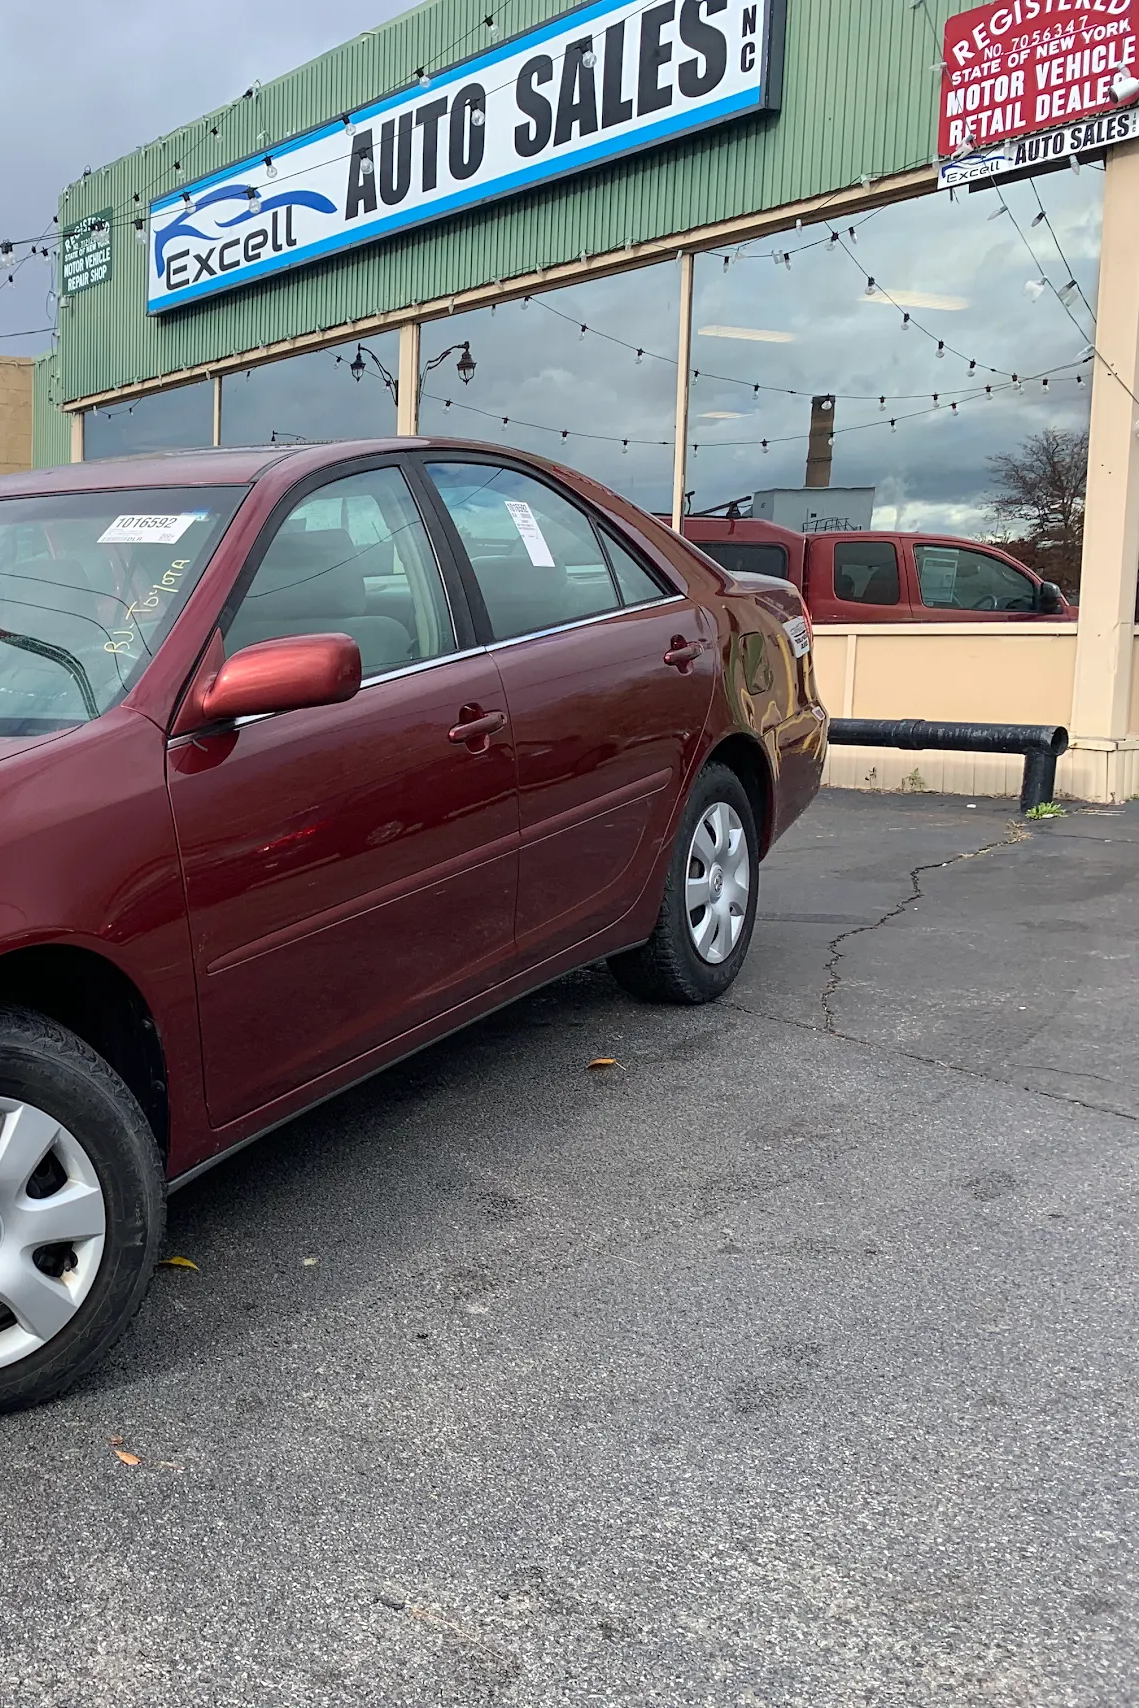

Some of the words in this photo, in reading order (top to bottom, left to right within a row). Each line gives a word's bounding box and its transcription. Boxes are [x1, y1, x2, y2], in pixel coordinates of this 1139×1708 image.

[952, 59, 1001, 86] STATE
[1007, 50, 1031, 67] OF
[1036, 35, 1075, 60] NEW
[1082, 17, 1131, 44] YORK
[1012, 15, 1089, 51] 7056347
[946, 70, 1025, 118] MOTOR
[1035, 35, 1136, 91] VEHICLE
[949, 102, 1026, 147] RETAIL
[166, 204, 297, 291] Excell
[344, 82, 486, 221] AUTO
[514, 0, 728, 158] SALES
[946, 161, 1001, 183] Excell
[1014, 133, 1065, 166] AUTO
[1070, 114, 1130, 150] SALES
[64, 258, 84, 278] MOTOR
[85, 246, 111, 269] VEHICLE
[65, 250, 79, 262] STATE
[78, 248, 86, 256] OF
[86, 243, 97, 254] NEW
[67, 271, 89, 292] REPAIR
[90, 264, 108, 283] SHOP
[116, 517, 178, 529] 1016592
